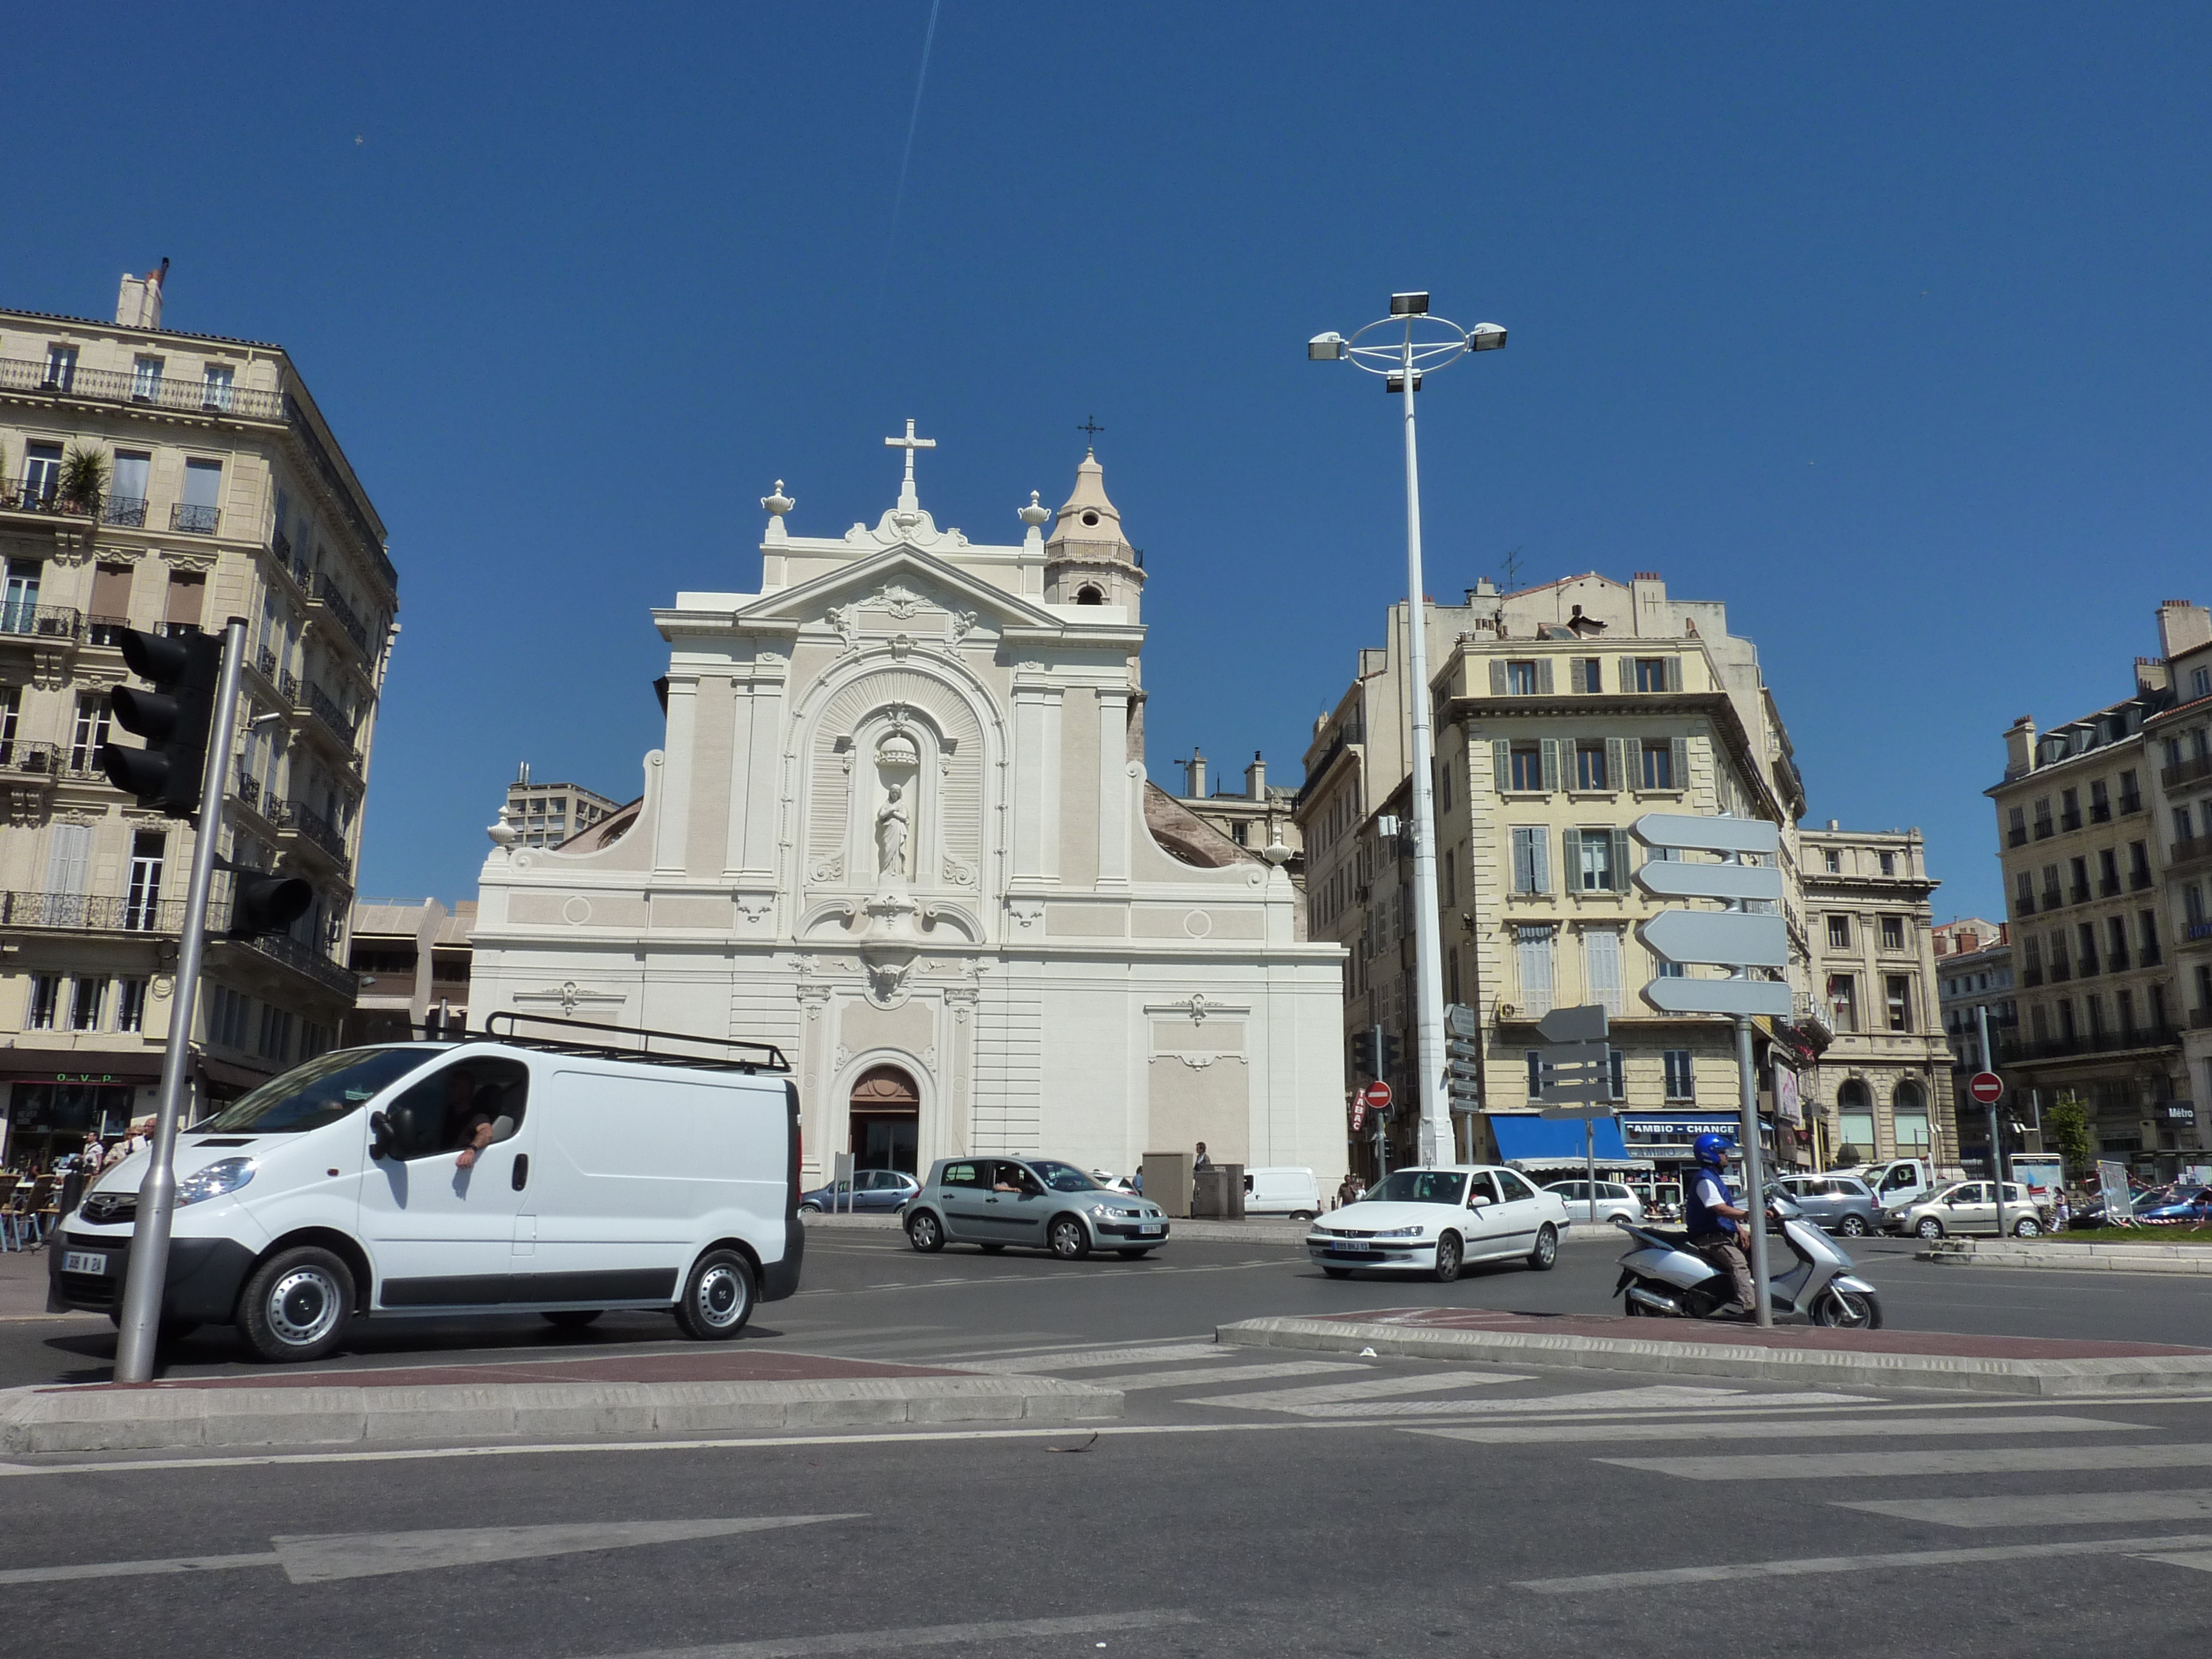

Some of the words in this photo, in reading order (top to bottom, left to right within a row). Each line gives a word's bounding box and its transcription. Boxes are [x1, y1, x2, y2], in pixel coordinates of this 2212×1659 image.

[57, 1073, 66, 1082] O
[80, 1074, 89, 1082] V
[102, 1074, 112, 1083] P
[1353, 1090, 1365, 1130] TABAC
[2168, 1107, 2193, 1118] Métro
